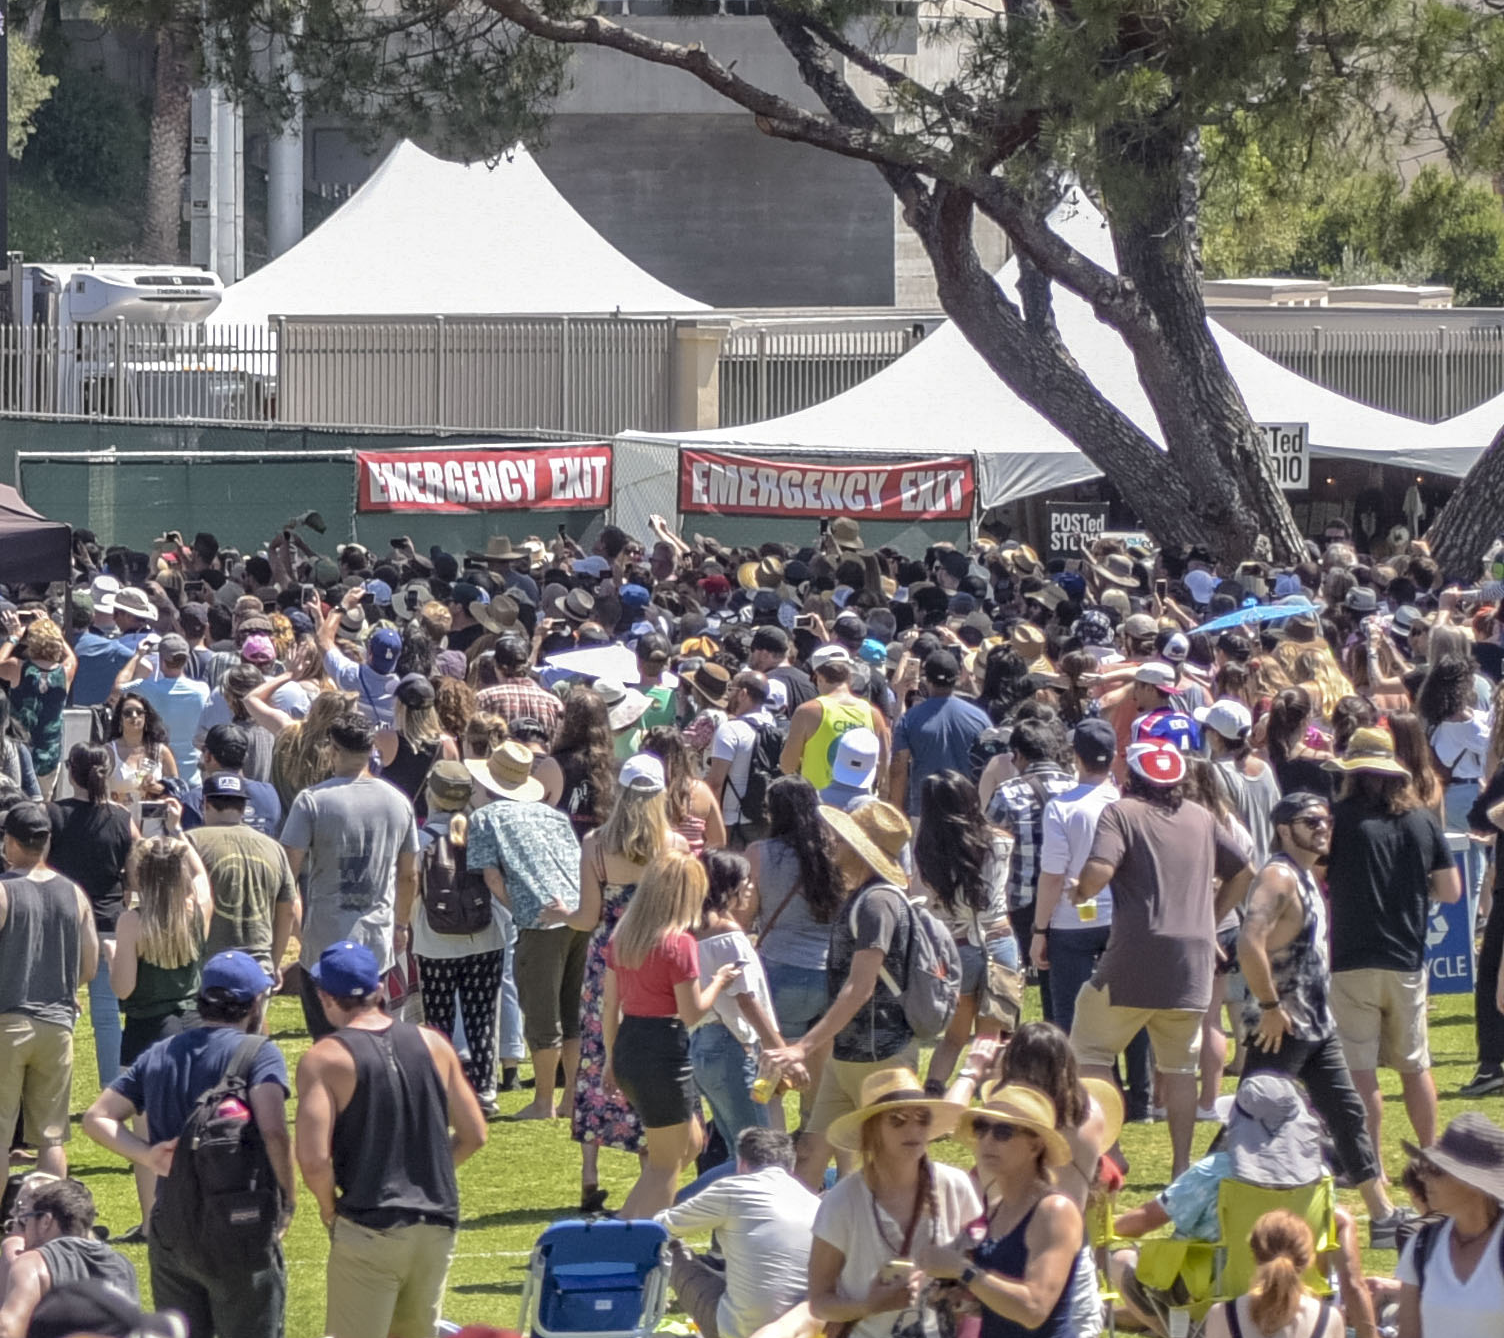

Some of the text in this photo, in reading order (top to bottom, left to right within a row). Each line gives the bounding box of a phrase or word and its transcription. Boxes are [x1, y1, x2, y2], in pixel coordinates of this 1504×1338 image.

[369, 455, 608, 505] EMERGENCY EXIT
[692, 462, 965, 514] EMERGENCY EXIT
[1050, 512, 1105, 532] POSTed
